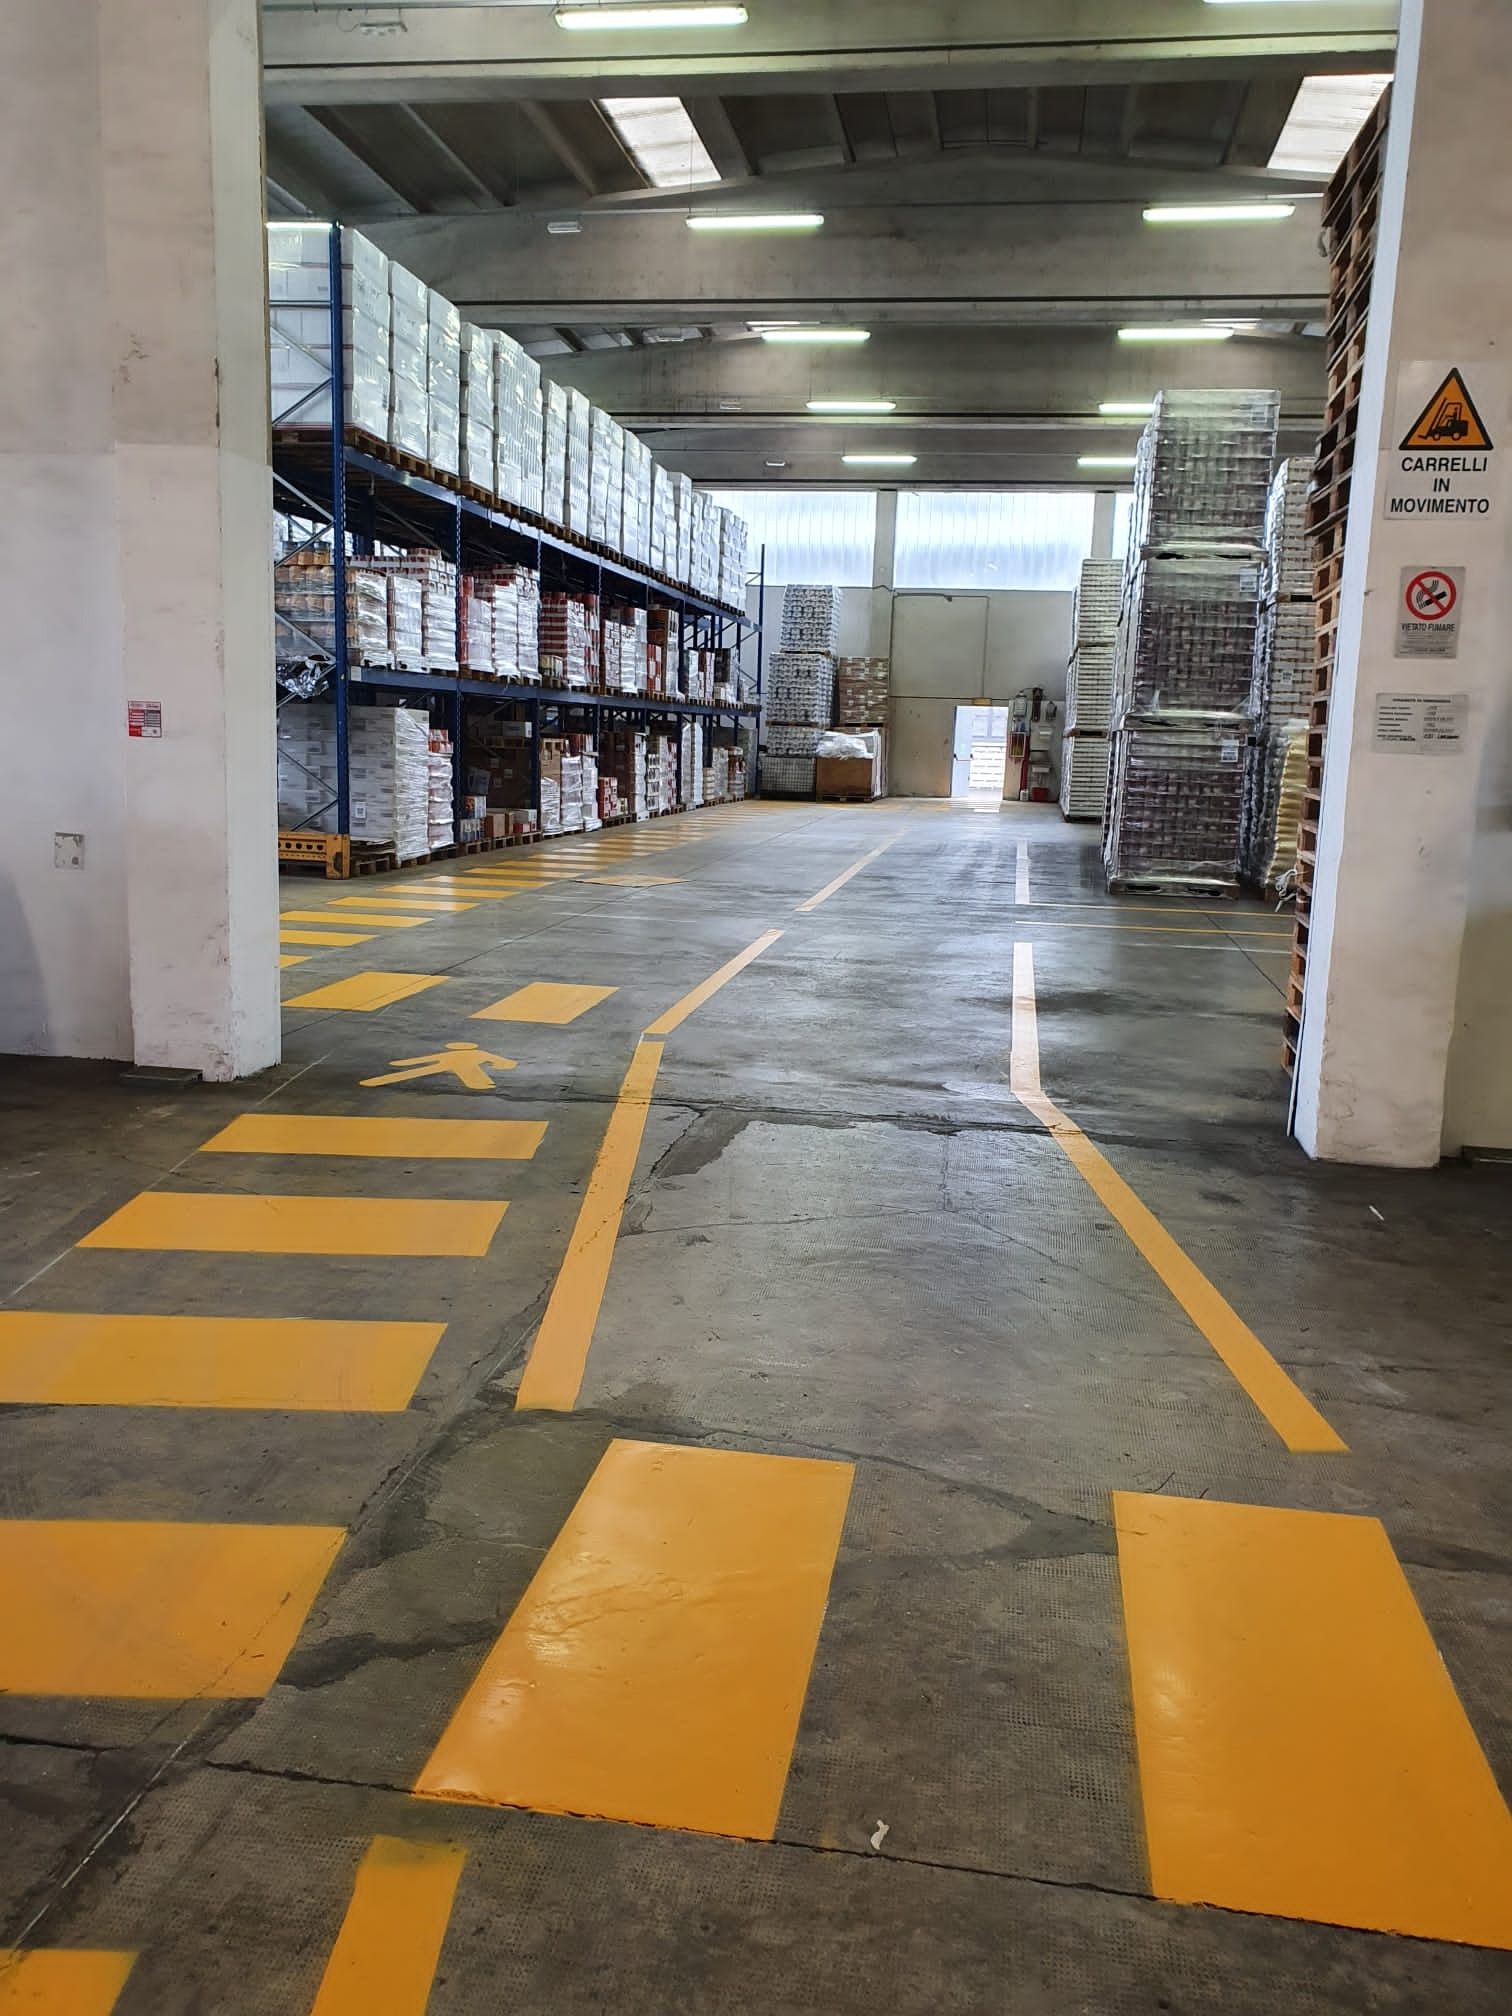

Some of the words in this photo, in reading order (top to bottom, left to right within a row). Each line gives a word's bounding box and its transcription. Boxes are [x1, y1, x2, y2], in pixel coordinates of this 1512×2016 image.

[1401, 456, 1488, 472] CARRELLI
[1433, 477, 1450, 493] IN
[1390, 498, 1490, 514] MOVIMENTO
[1401, 623, 1427, 632] VIETATO
[1428, 623, 1456, 632] FUMARE
